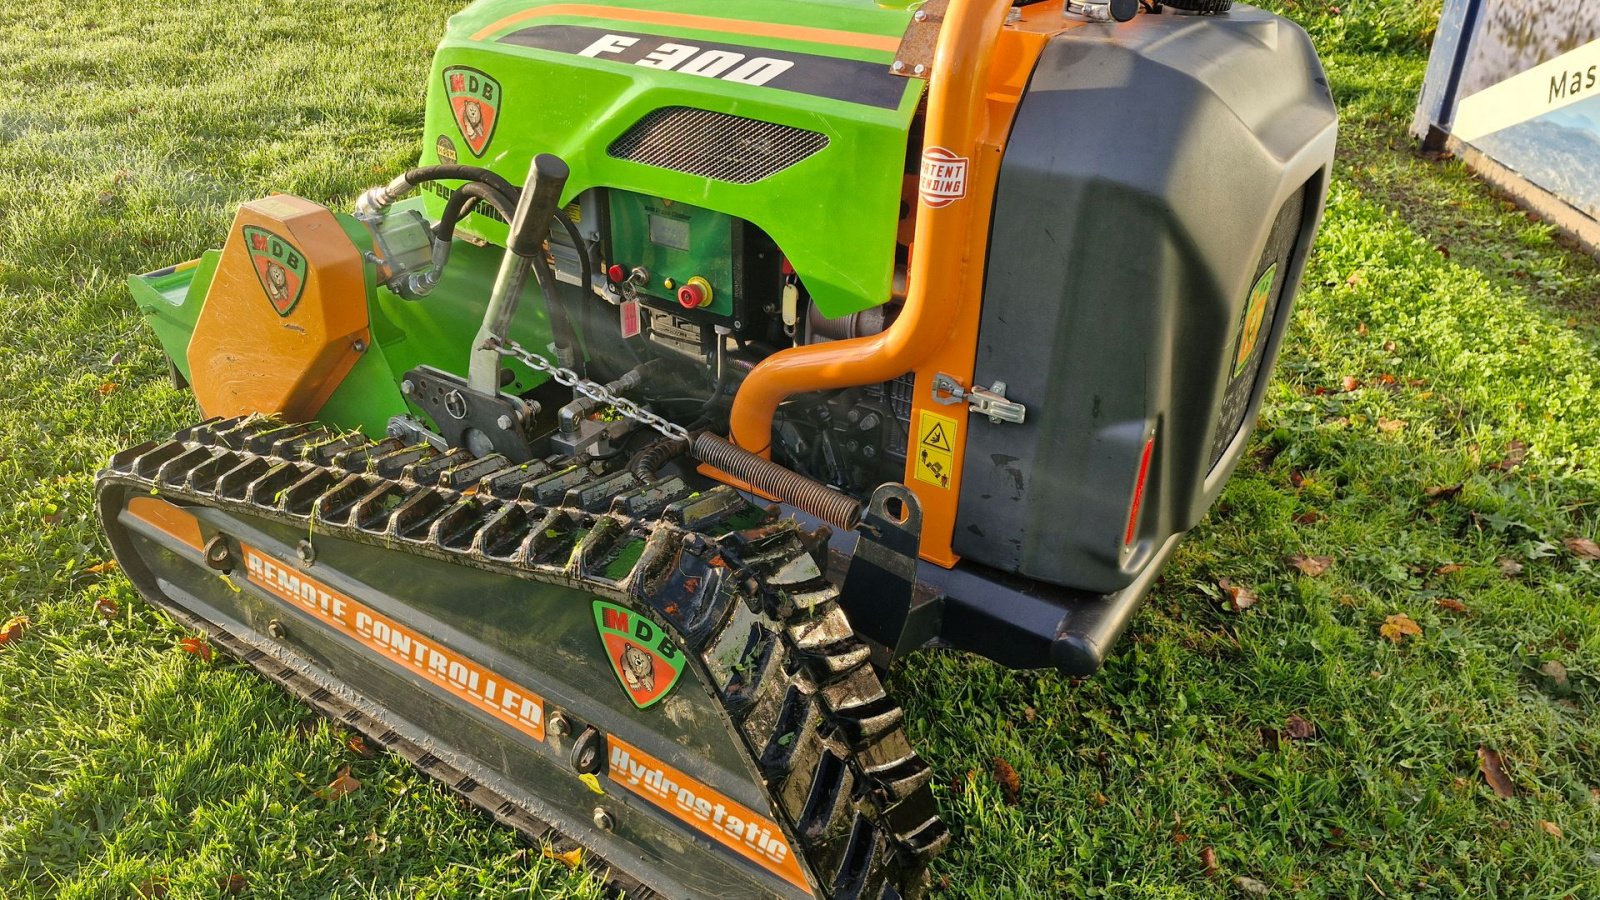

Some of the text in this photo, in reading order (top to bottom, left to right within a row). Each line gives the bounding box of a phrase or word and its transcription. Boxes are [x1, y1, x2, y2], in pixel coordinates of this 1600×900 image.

[577, 33, 795, 87] F 300
[248, 551, 542, 729] REMOTE CONTROLLED
[602, 607, 678, 659] MDB
[609, 745, 788, 864] Hydrostatic
